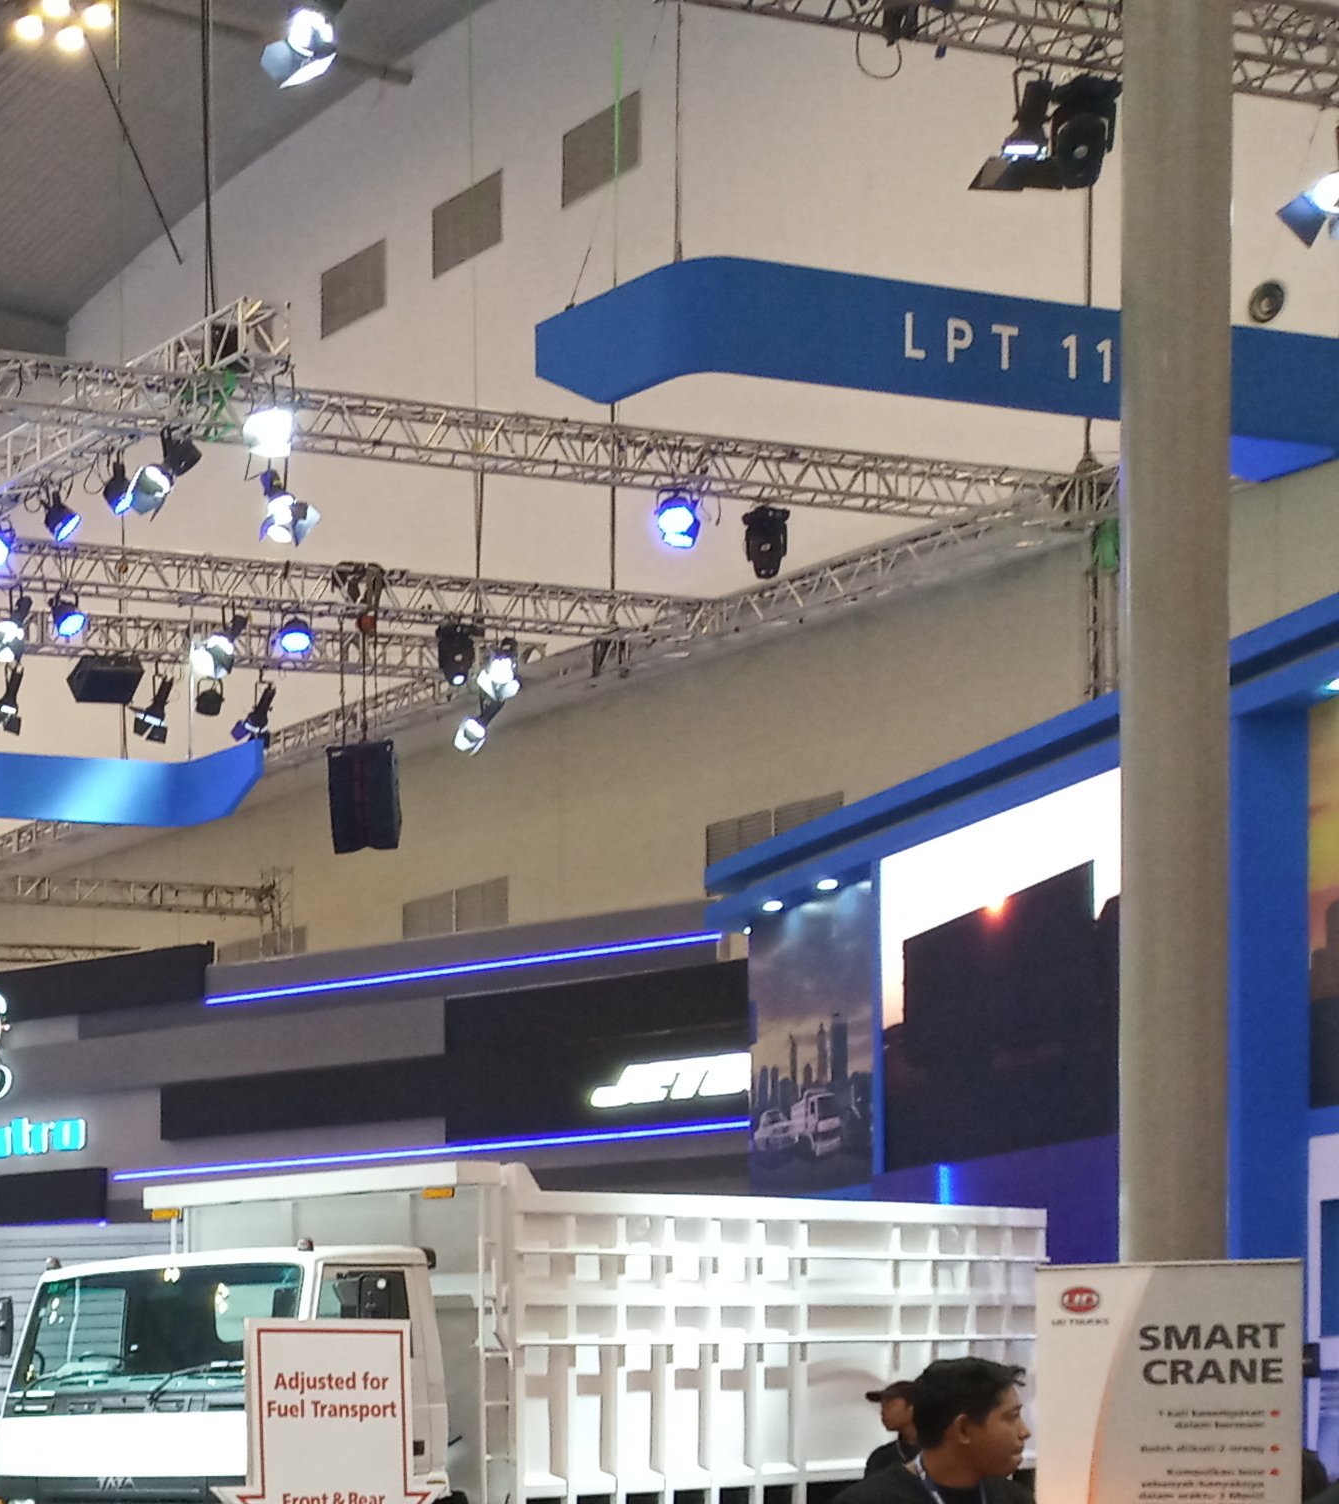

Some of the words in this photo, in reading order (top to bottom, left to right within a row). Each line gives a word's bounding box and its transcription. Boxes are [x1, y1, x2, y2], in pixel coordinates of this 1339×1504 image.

[904, 311, 1019, 371] LPT
[1139, 1323, 1285, 1351] SMART
[274, 1371, 356, 1395] Adjusted
[362, 1371, 389, 1390] for
[1142, 1358, 1284, 1385] CRANE
[267, 1399, 305, 1418] Fuel
[311, 1400, 397, 1422] Transport
[97, 1476, 135, 1491] TATA
